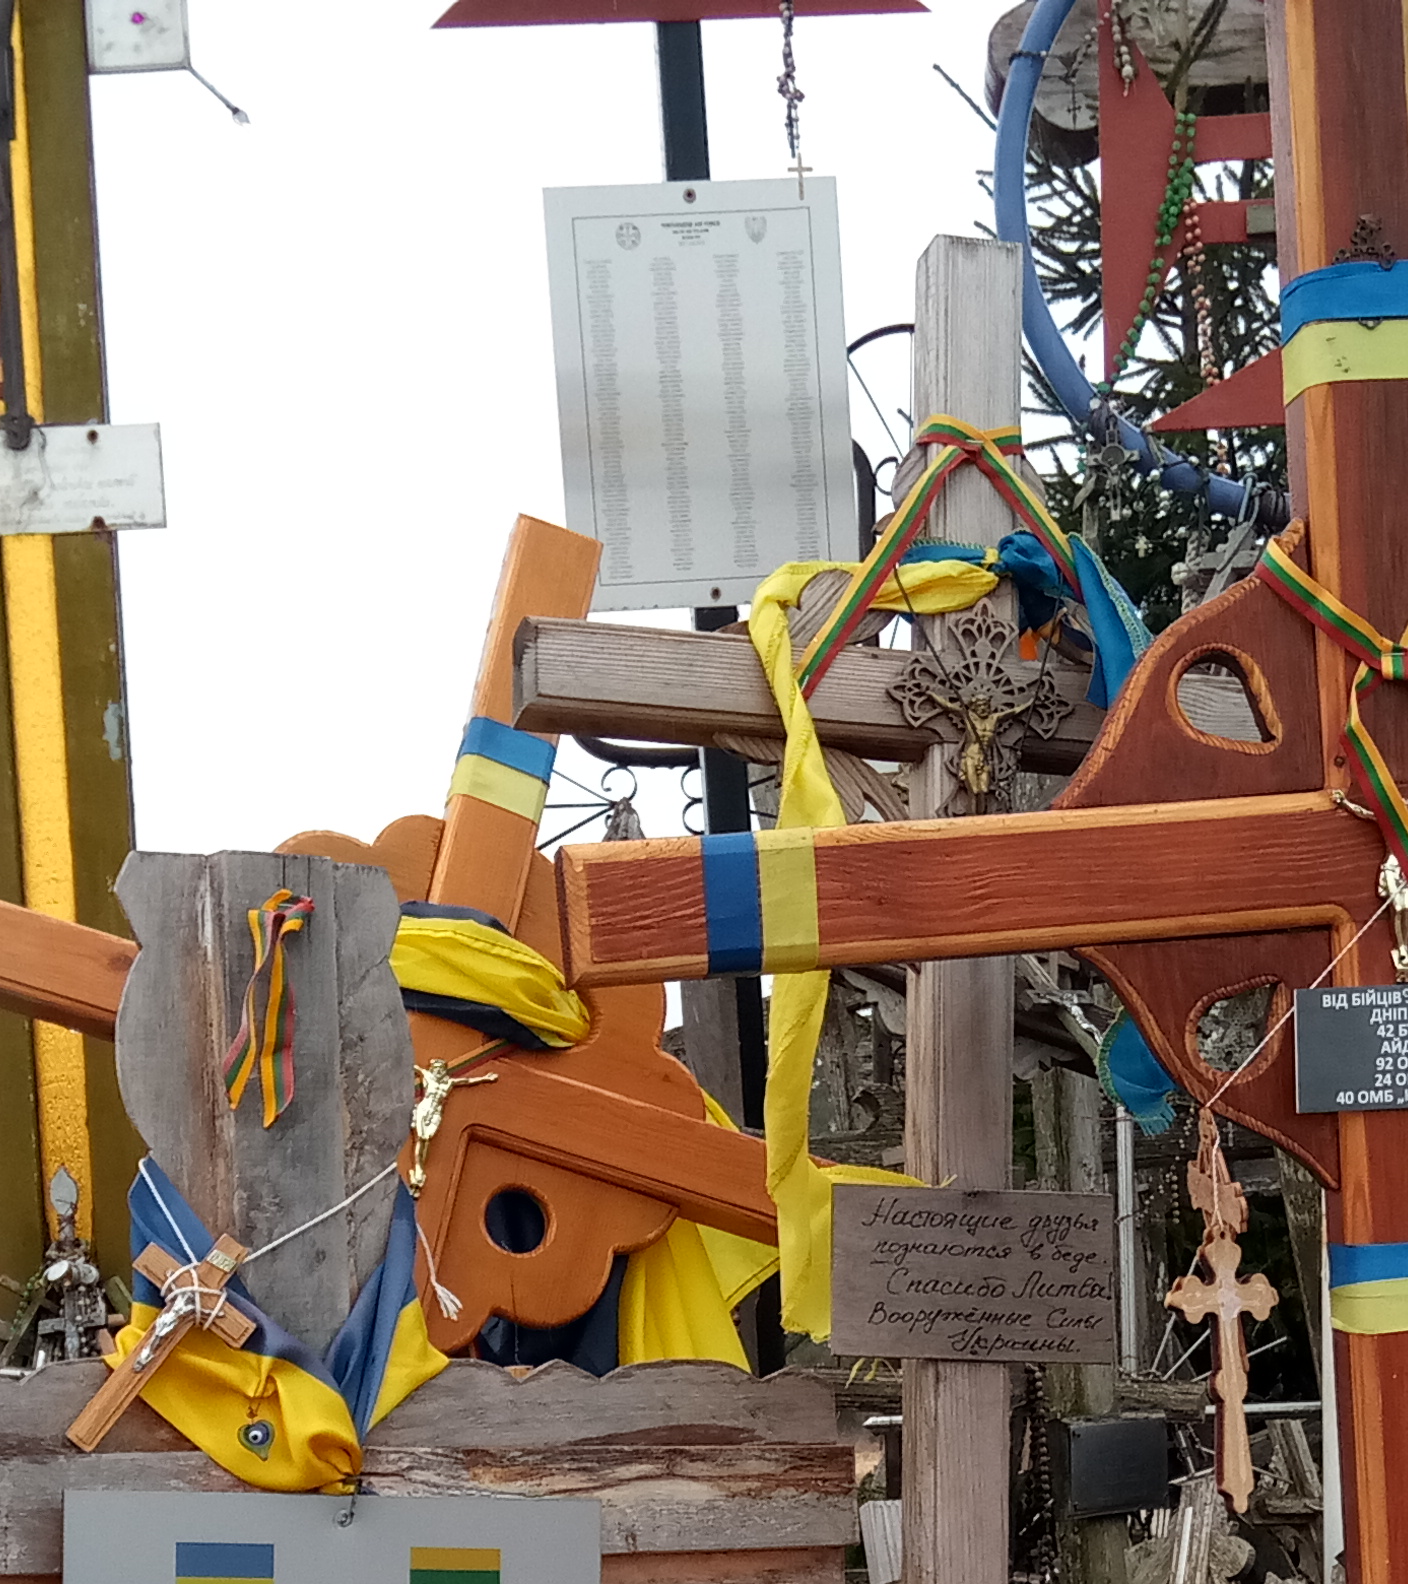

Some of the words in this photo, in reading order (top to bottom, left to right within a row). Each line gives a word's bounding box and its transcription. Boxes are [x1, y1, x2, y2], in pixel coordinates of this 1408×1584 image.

[1322, 994, 1348, 1009] ВІД
[1352, 989, 1402, 1006] БІЙЦІВ
[1377, 1024, 1394, 1038] 42
[1376, 1058, 1392, 1071] 92
[1374, 1074, 1392, 1087] 24
[1336, 1091, 1355, 1105] 40
[1358, 1090, 1393, 1103] ОМБ
[861, 1197, 1018, 1236] Настоящие
[1020, 1212, 1099, 1247] друзья
[871, 1239, 1012, 1266] познаются
[1028, 1246, 1041, 1261] в
[886, 1266, 1006, 1298] Спасибо
[1012, 1270, 1114, 1301] Литва!
[1046, 1307, 1104, 1331] Силы
[948, 1326, 1082, 1355] Украины.
